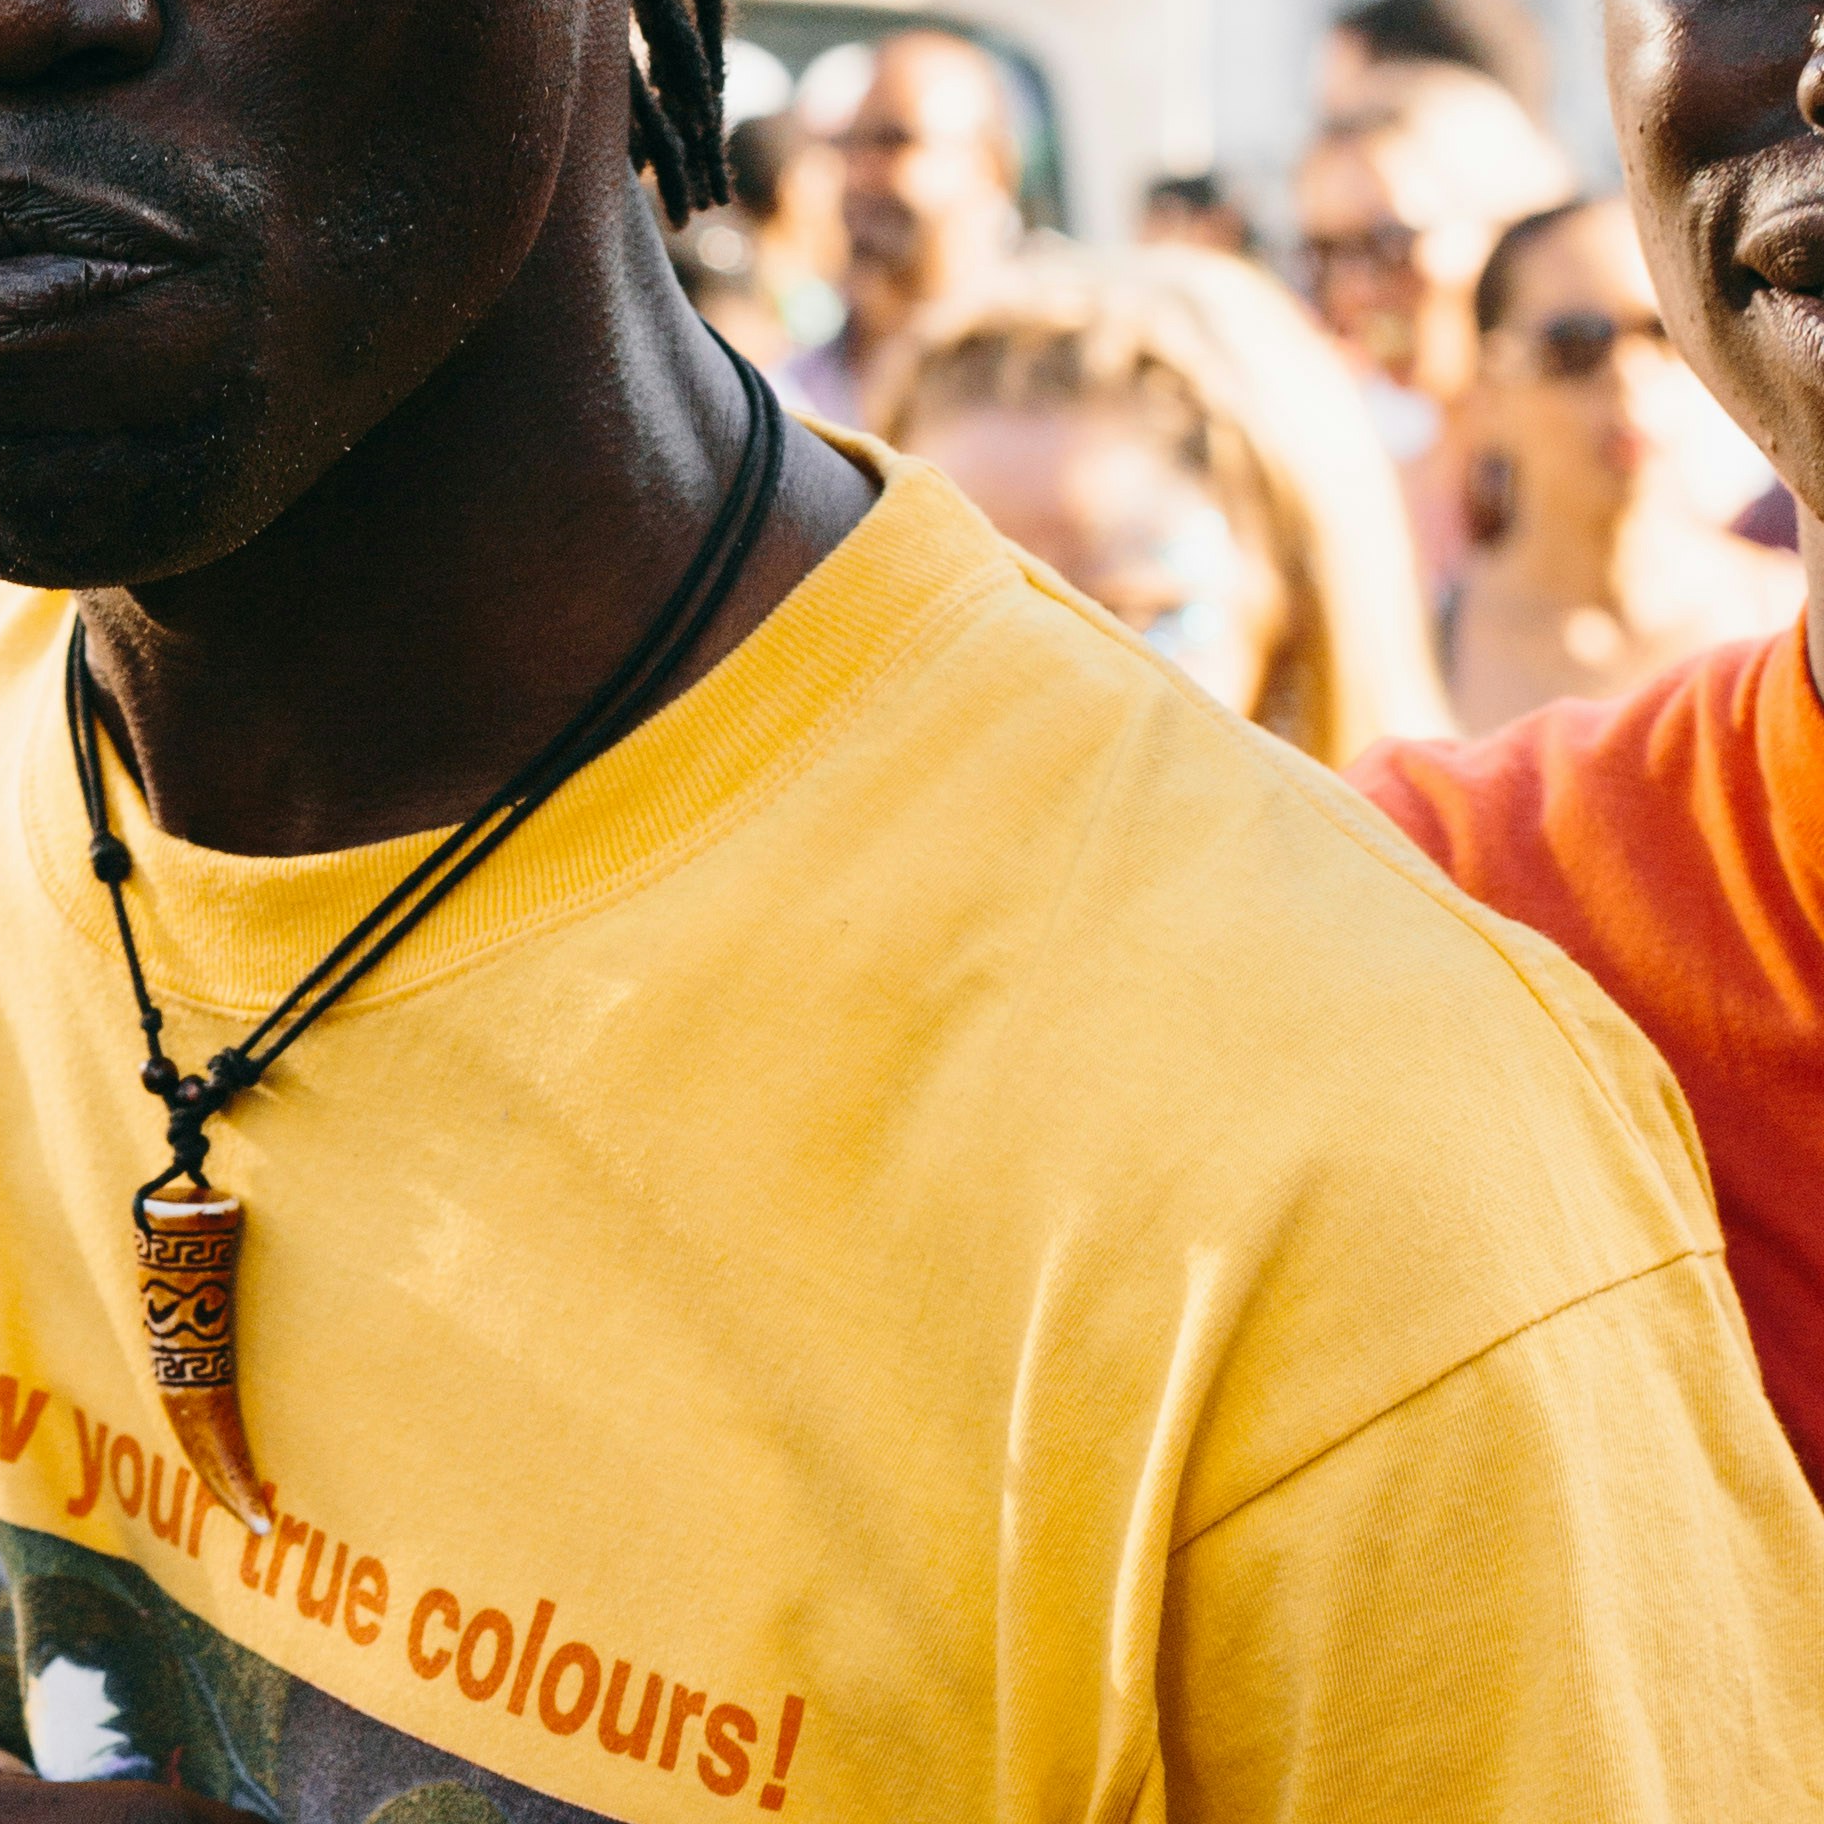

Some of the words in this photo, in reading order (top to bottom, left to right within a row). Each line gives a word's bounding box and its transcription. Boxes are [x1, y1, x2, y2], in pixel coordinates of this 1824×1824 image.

[66, 1406, 221, 1560] your
[239, 1478, 389, 1647] true
[406, 1587, 806, 1813] colours!
